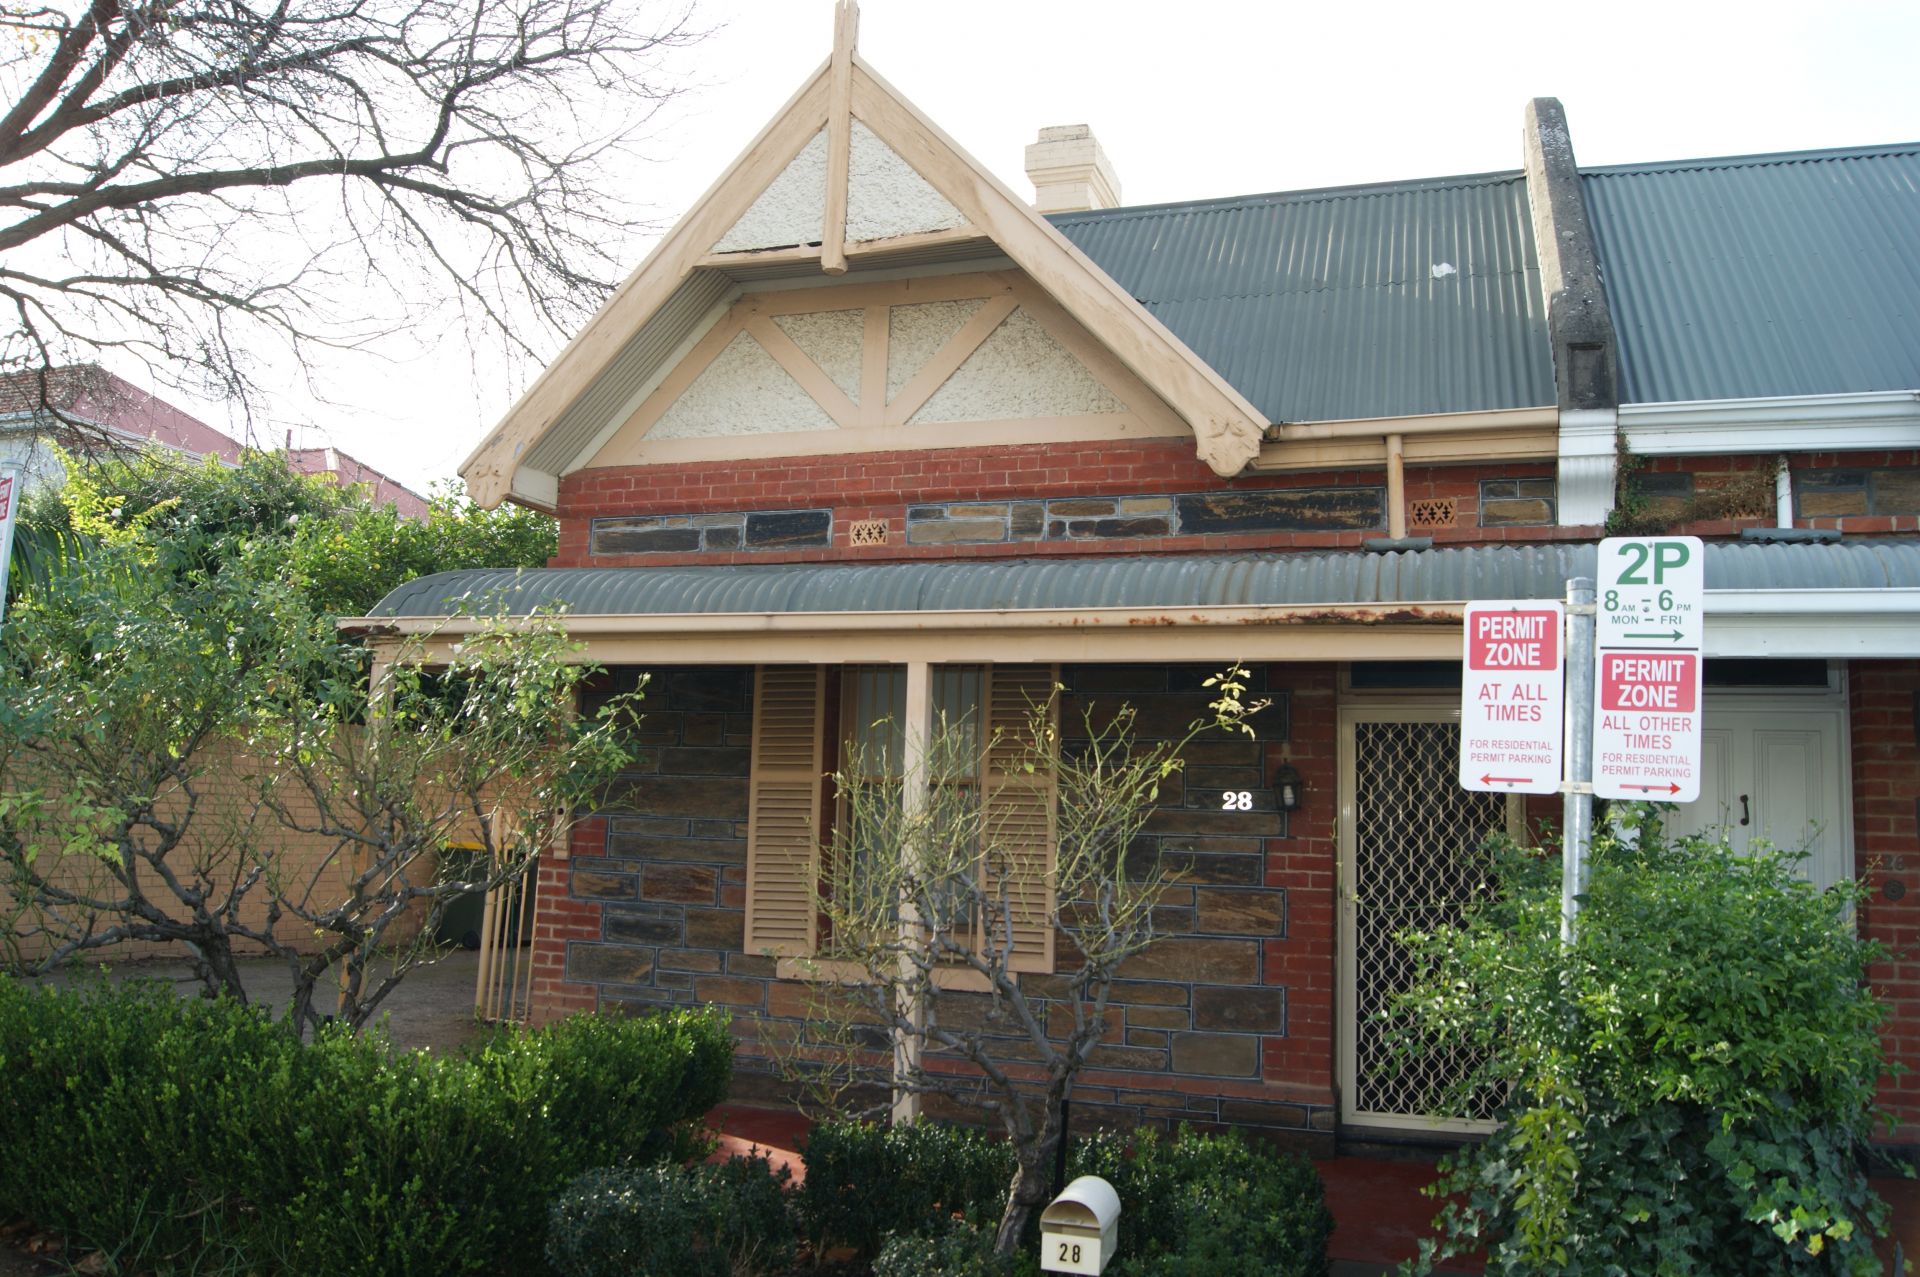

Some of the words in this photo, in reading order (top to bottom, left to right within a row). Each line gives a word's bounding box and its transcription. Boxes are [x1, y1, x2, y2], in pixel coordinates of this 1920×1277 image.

[1616, 542, 1690, 585] 2P
[1478, 616, 1547, 640] PERMIT
[1611, 615, 1639, 625] MON
[1660, 615, 1682, 625] FRI
[1484, 643, 1541, 666] ZONE
[1611, 659, 1685, 682] PERMIT
[1479, 684, 1502, 701] AT
[1512, 684, 1548, 701] ALL
[1617, 685, 1678, 708] ZONE
[1484, 704, 1542, 722] TIMES
[1602, 715, 1631, 730] ALL
[1639, 716, 1692, 732] OTHER
[1469, 739, 1489, 750] FOR
[1491, 740, 1553, 751] RESIDENTIAL
[1623, 734, 1672, 750] TIMES
[1470, 753, 1506, 763] PERMIT
[1508, 754, 1552, 765] PARKING
[1602, 753, 1623, 763] FOR
[1625, 754, 1691, 766] RESIDENTIAL
[1602, 765, 1640, 776] PERMIT
[1643, 767, 1691, 779] PARKING
[1222, 791, 1252, 810] 28
[1059, 1243, 1081, 1263] 28
